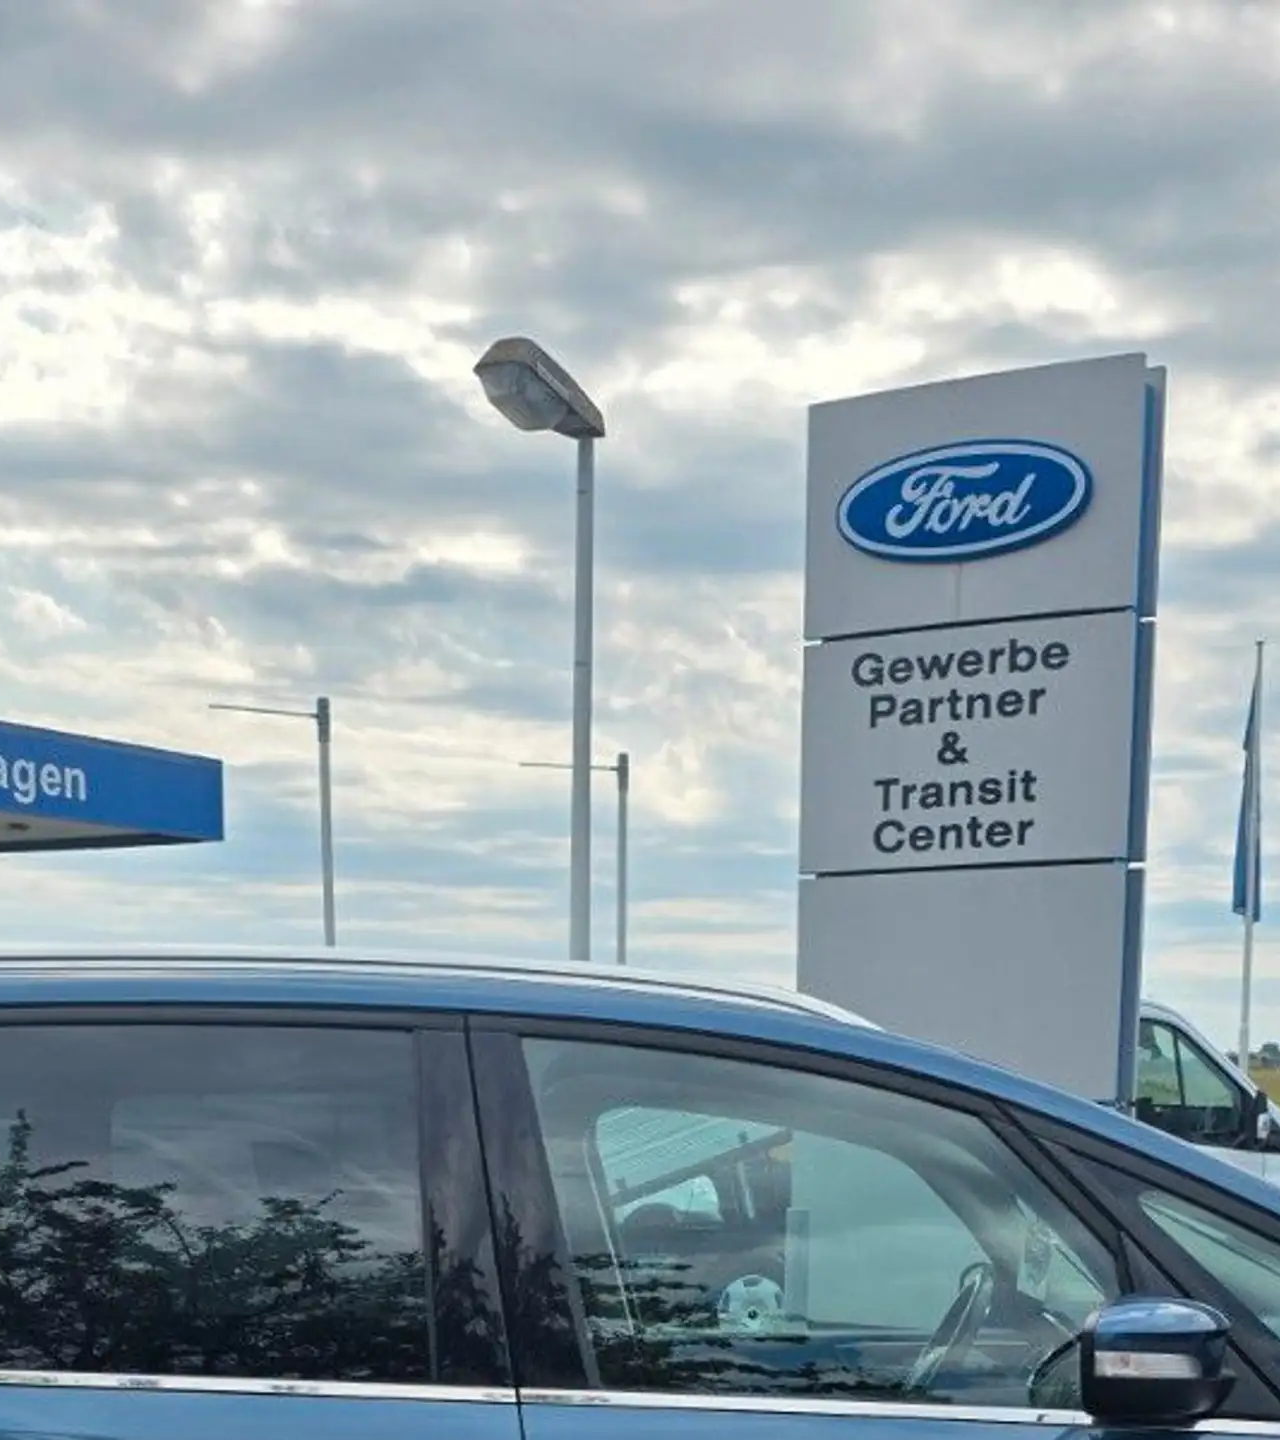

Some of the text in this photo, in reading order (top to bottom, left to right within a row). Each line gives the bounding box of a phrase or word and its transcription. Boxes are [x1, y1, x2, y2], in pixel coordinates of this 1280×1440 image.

[884, 461, 1036, 539] Ford
[851, 638, 1070, 688] Gewerbe
[869, 686, 1046, 729] Partner
[936, 731, 969, 766] &
[874, 769, 1037, 812] Transit
[872, 815, 1034, 854] Center
